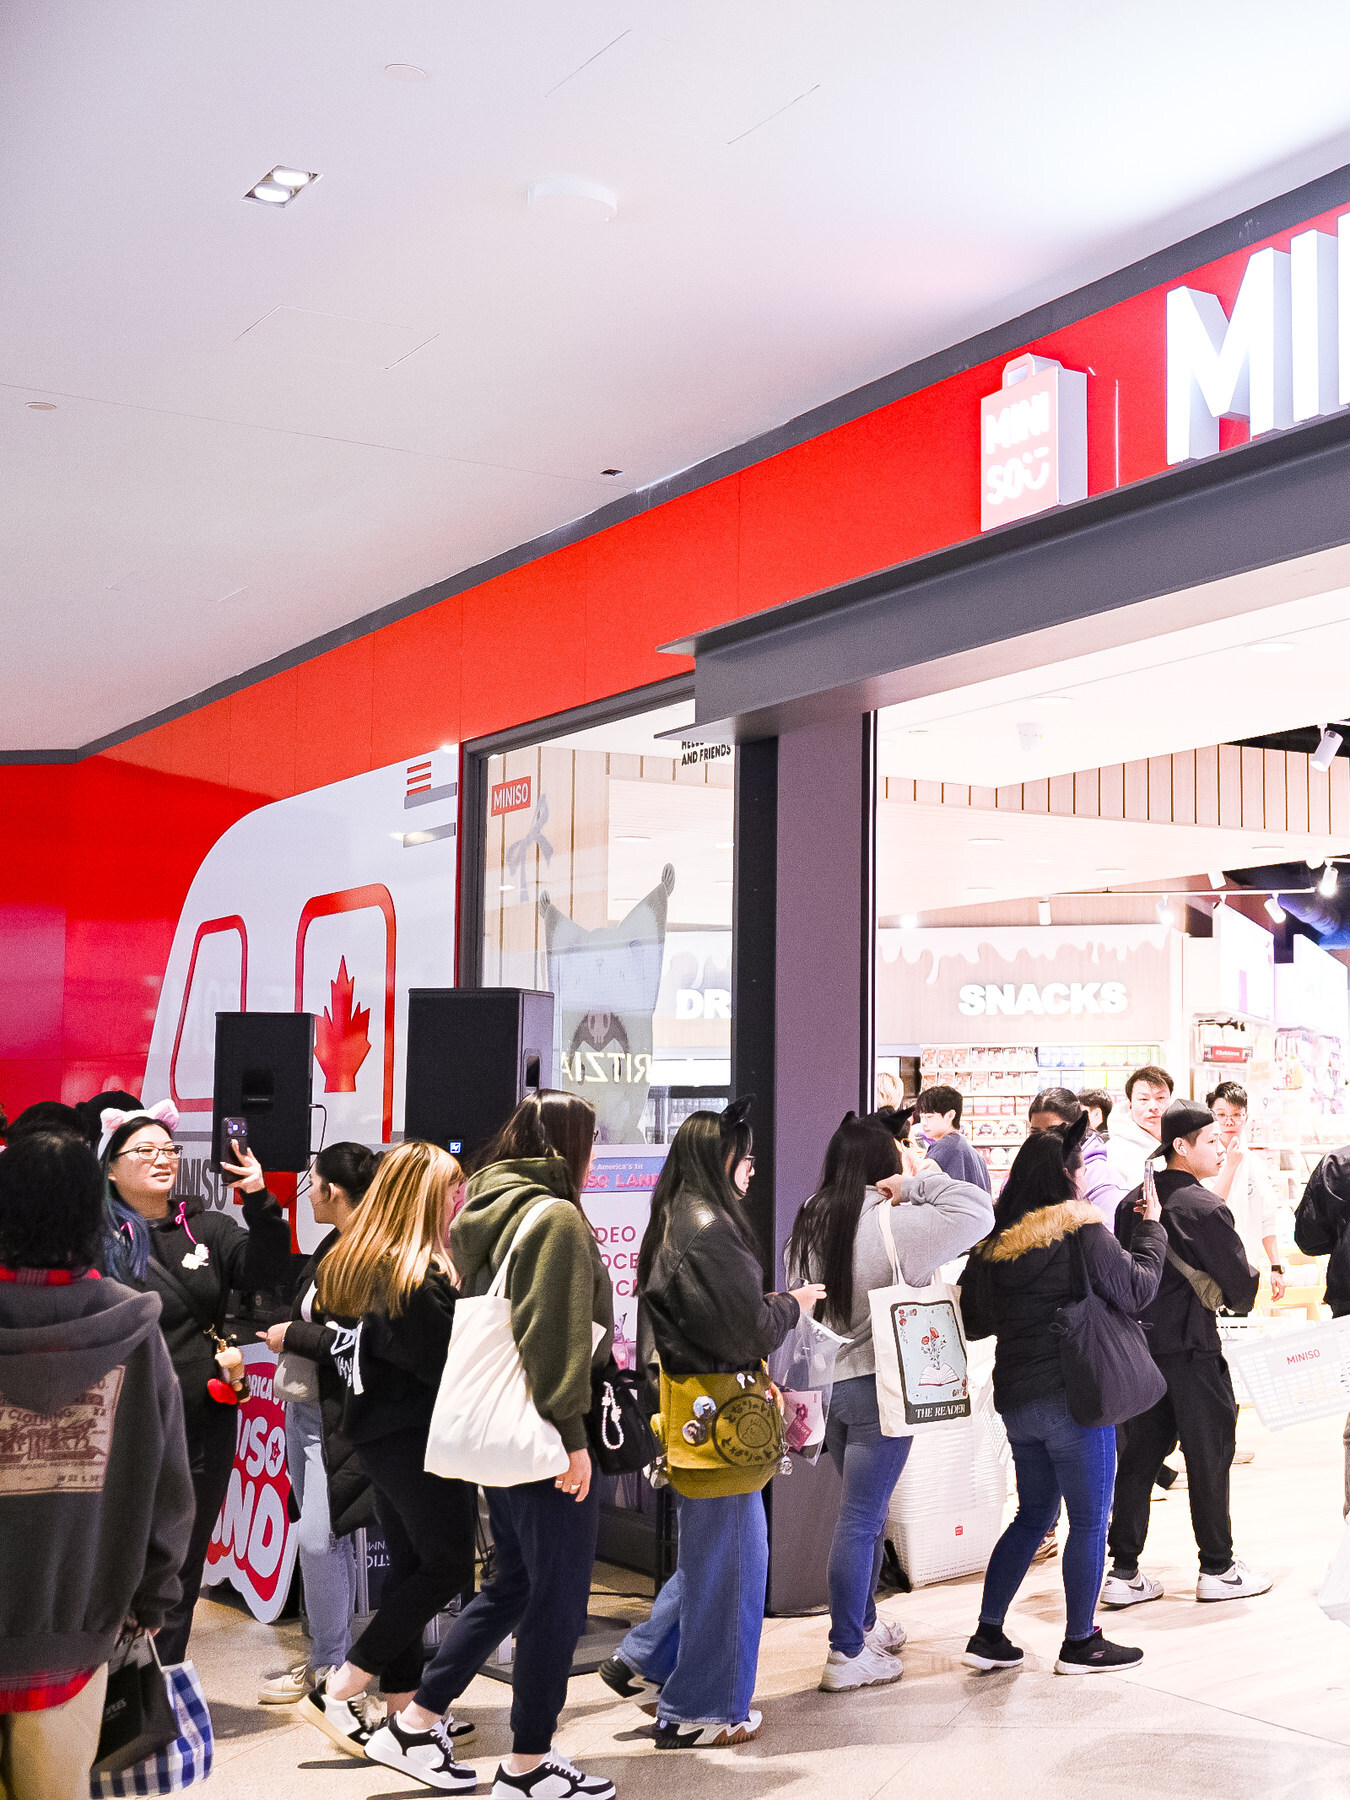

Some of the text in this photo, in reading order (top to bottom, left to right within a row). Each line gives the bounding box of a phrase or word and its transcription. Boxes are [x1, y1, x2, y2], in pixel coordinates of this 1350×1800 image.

[681, 744, 731, 766] AND FRIENDS
[493, 782, 529, 810] MINISO
[676, 988, 732, 1020] DR
[958, 980, 1128, 1017] SNACKS
[596, 1163, 633, 1171] America's
[168, 1157, 228, 1211] INISO
[595, 1225, 636, 1244] DEO
[1286, 1348, 1321, 1365] MINISO
[915, 1404, 966, 1419] THE READER
